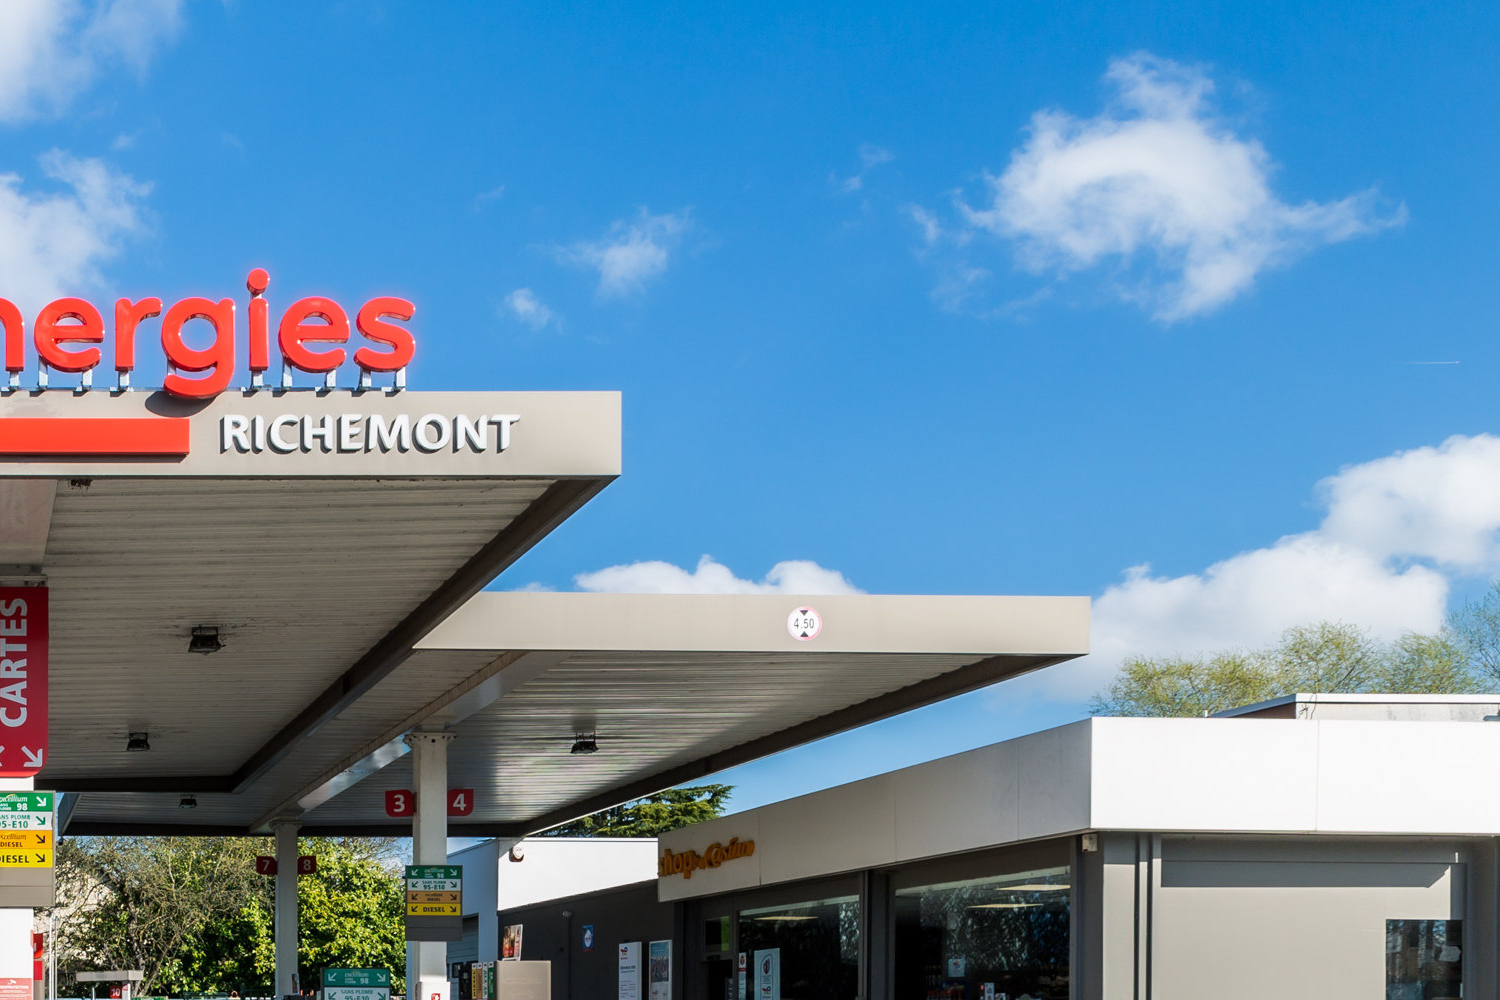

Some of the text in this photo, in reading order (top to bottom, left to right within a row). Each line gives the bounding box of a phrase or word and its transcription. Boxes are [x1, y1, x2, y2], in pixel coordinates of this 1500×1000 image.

[221, 413, 521, 453] RICHEMONT
[793, 618, 815, 629] 4.50
[0, 597, 28, 727] CARTES
[16, 803, 28, 811] 98
[393, 794, 405, 812] 3
[452, 793, 466, 811] 4
[704, 837, 754, 868] Casino
[262, 860, 270, 871] 7
[303, 859, 311, 870] 8
[111, 988, 120, 996] 10
